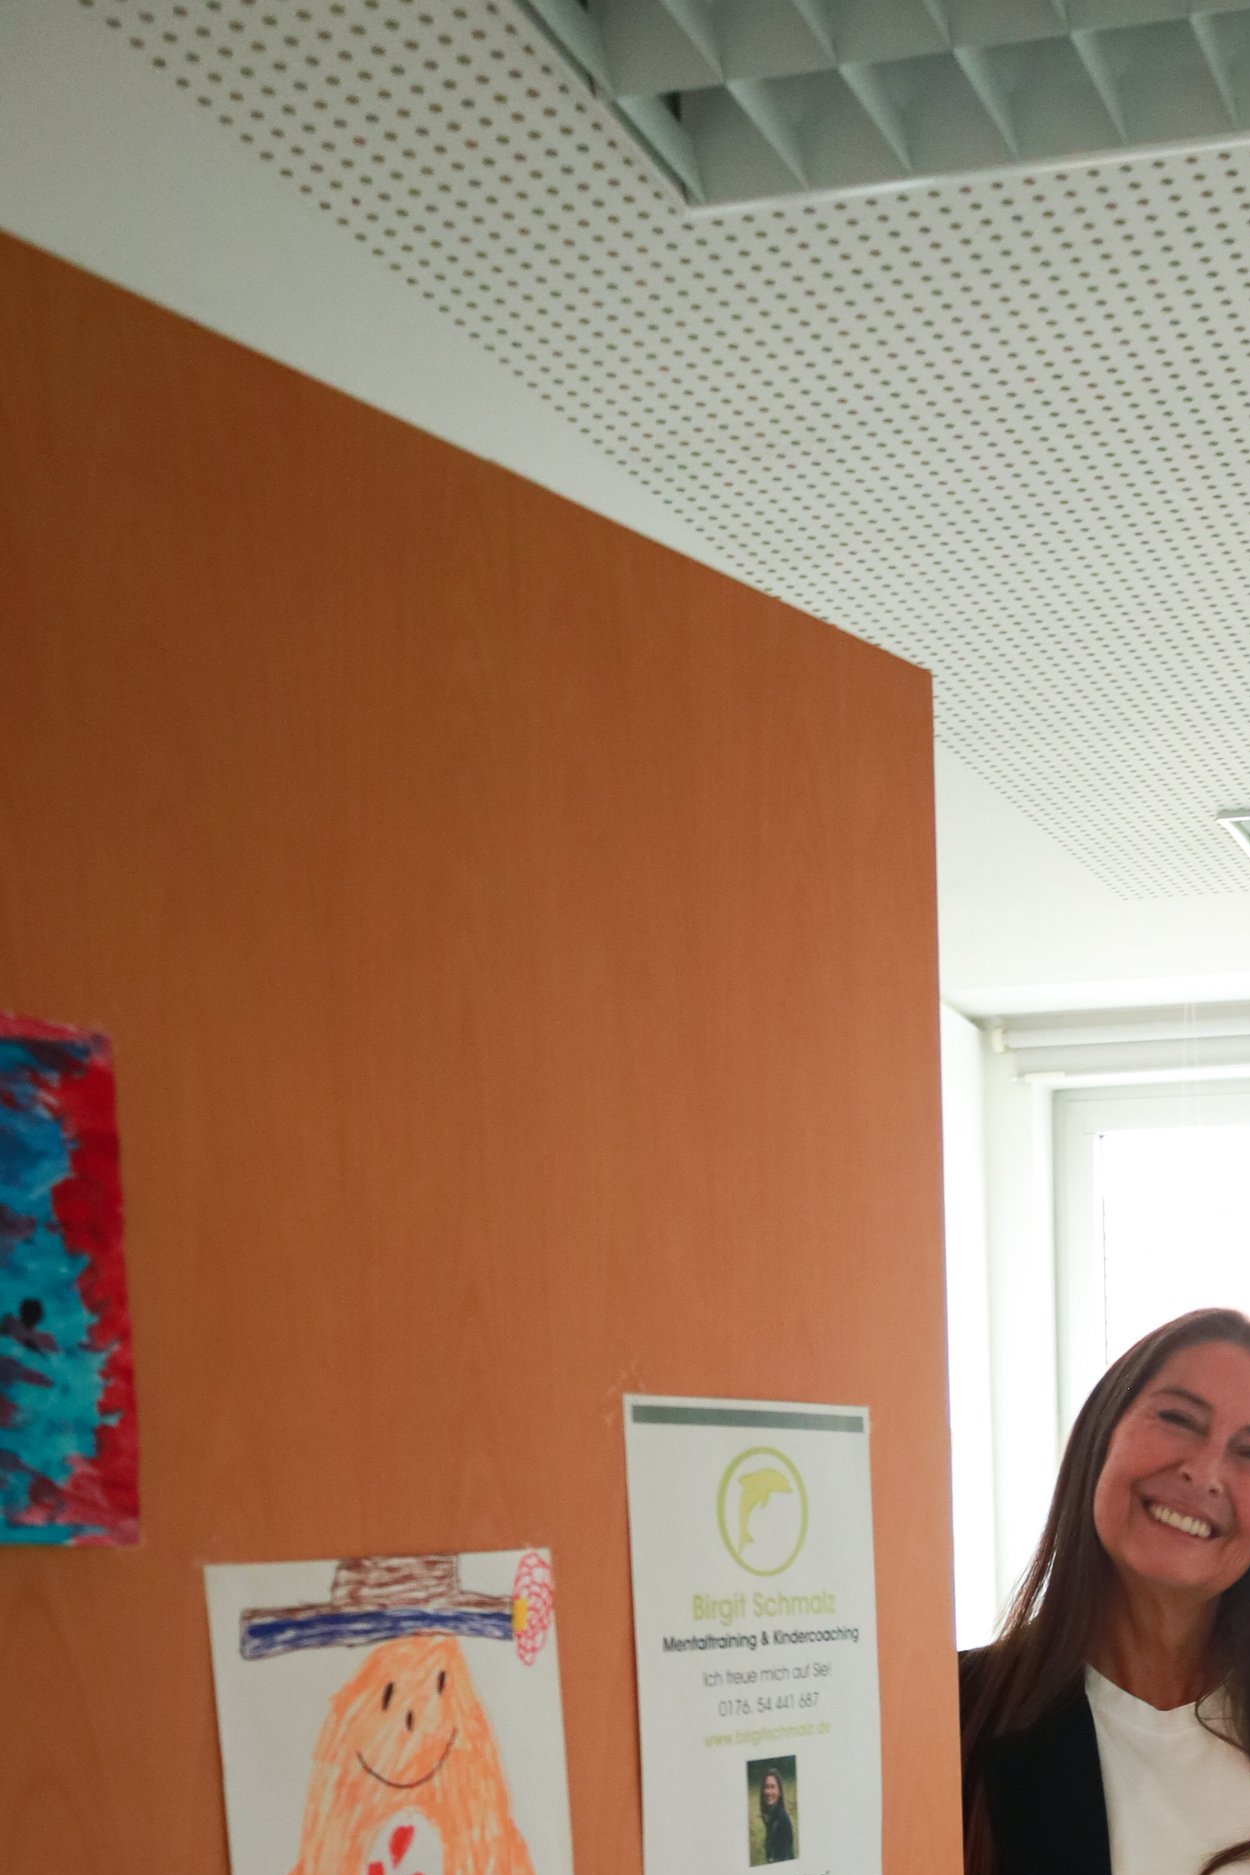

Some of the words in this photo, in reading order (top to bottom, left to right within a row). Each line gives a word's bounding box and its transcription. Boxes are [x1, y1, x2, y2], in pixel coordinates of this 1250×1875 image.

[692, 1593, 746, 1626] Birgit
[753, 1590, 836, 1617] Schmalz
[662, 1632, 757, 1652] Mentaltraining
[761, 1630, 769, 1646] &
[773, 1626, 859, 1645] Kindercoaching
[703, 1671, 723, 1688] Ich
[726, 1669, 758, 1685] freue
[760, 1665, 790, 1682] mich
[793, 1663, 810, 1679] auf
[756, 1697, 772, 1713] 54
